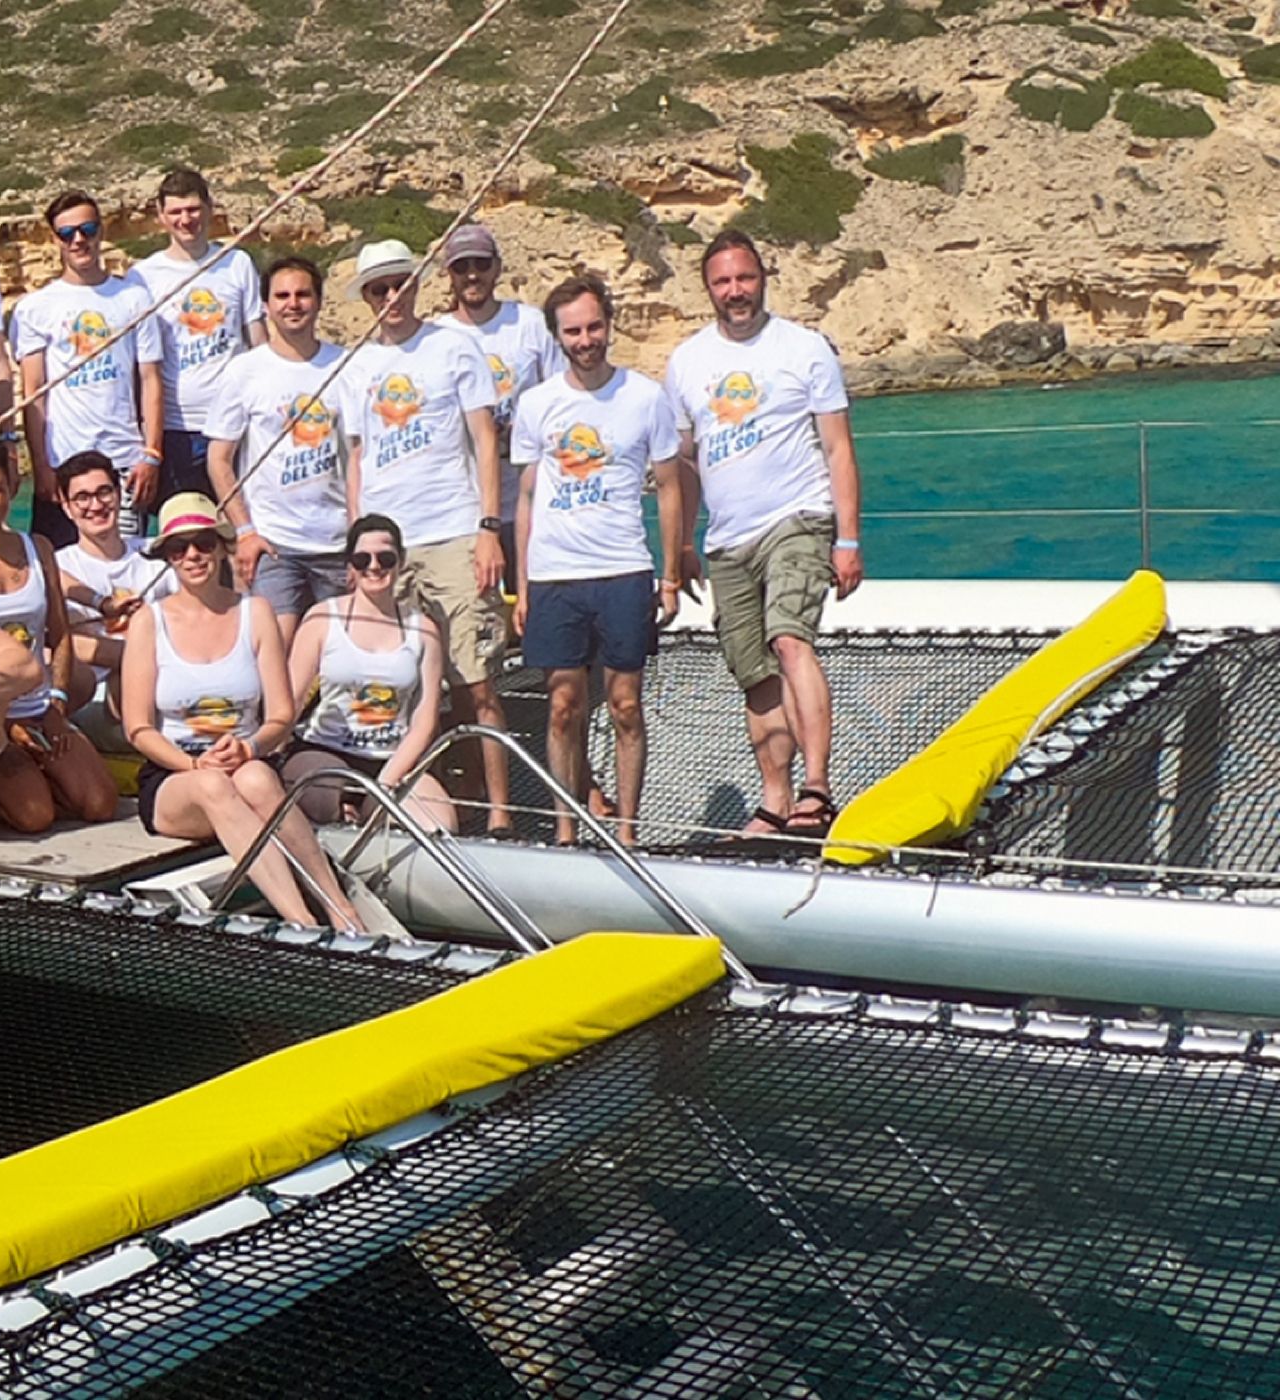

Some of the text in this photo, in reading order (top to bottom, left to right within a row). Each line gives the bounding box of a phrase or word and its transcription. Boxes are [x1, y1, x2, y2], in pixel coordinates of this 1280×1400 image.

[182, 328, 226, 355] FIESTA
[180, 351, 206, 371] DEL
[379, 419, 421, 449] FIESTA
[733, 430, 765, 452] SOL
[285, 441, 331, 468] FIESTA
[376, 431, 432, 468] DEL SOL
[281, 464, 309, 485] DEL
